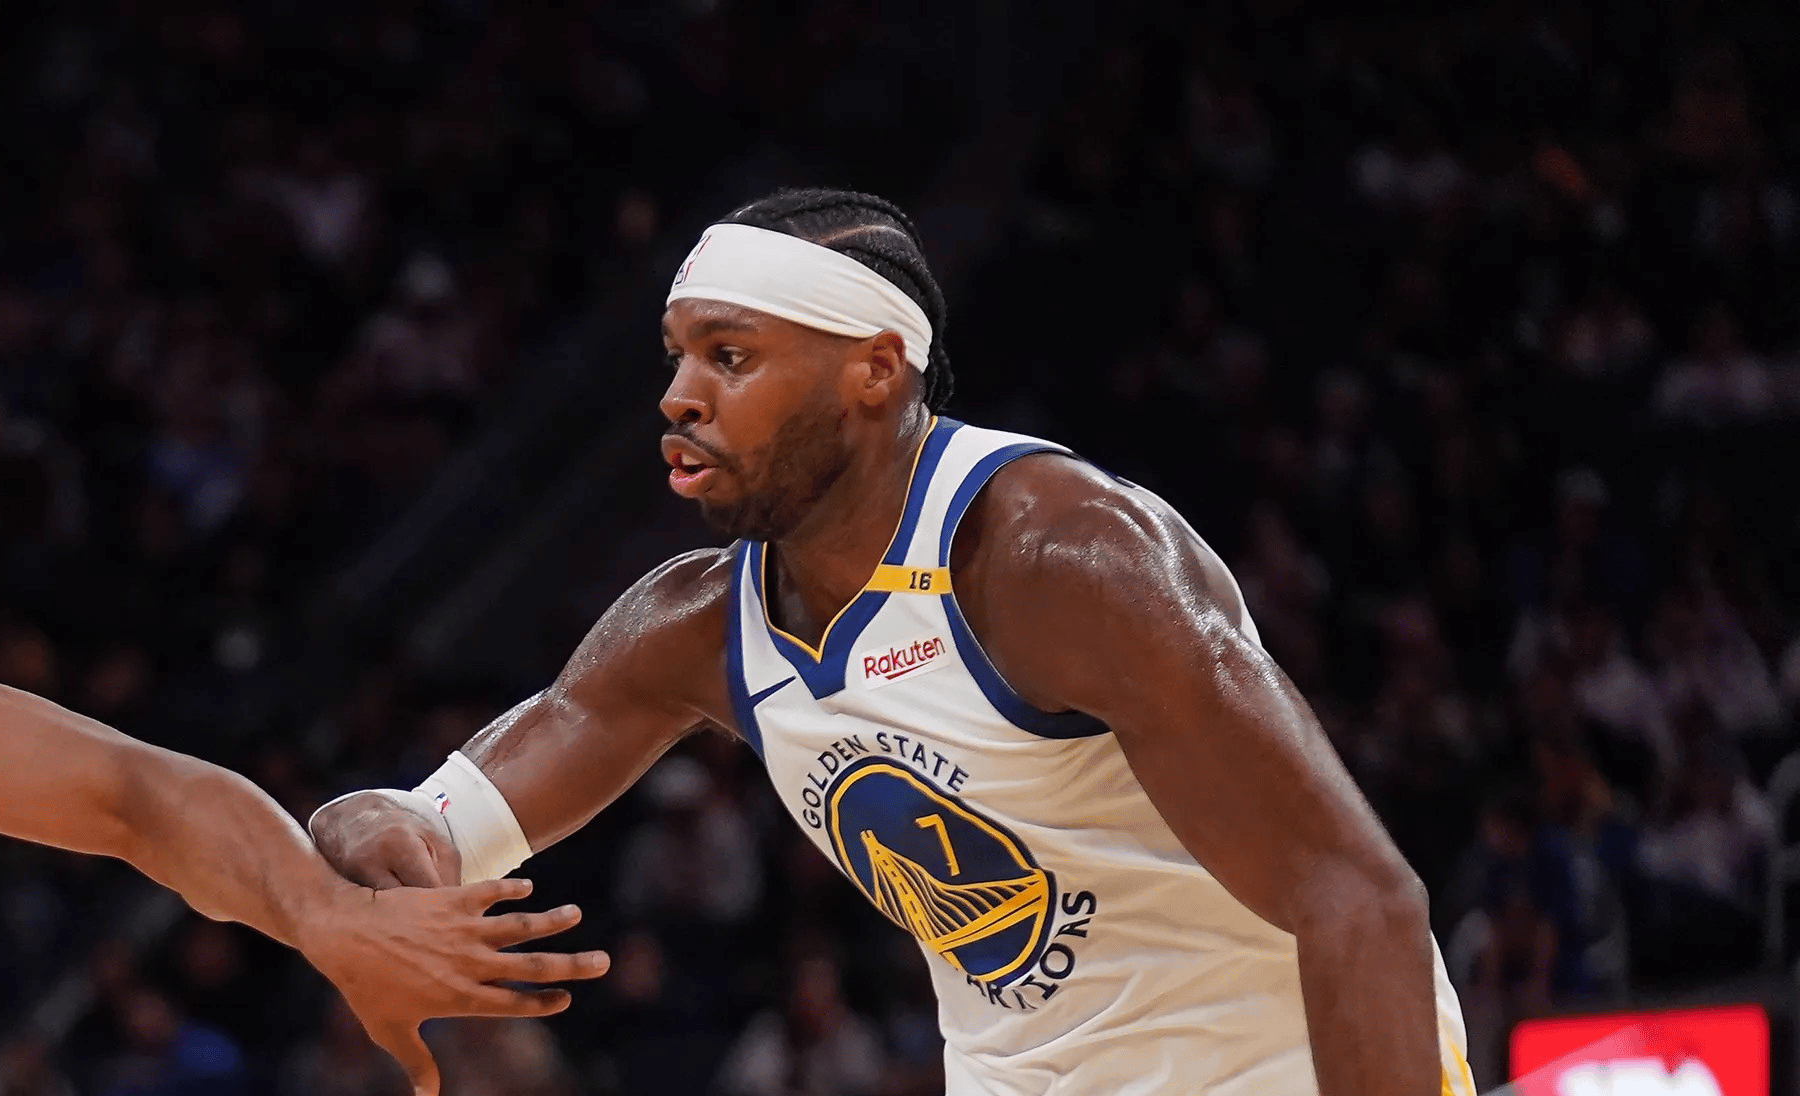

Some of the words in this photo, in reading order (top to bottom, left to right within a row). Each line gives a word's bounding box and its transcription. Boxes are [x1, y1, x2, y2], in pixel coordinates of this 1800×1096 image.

[909, 571, 932, 590] 16
[863, 637, 946, 679] Rakuten
[802, 734, 870, 829] GOLDEN
[876, 731, 969, 793] STATE
[915, 813, 960, 877] 7
[966, 890, 1098, 1009] RIORS
